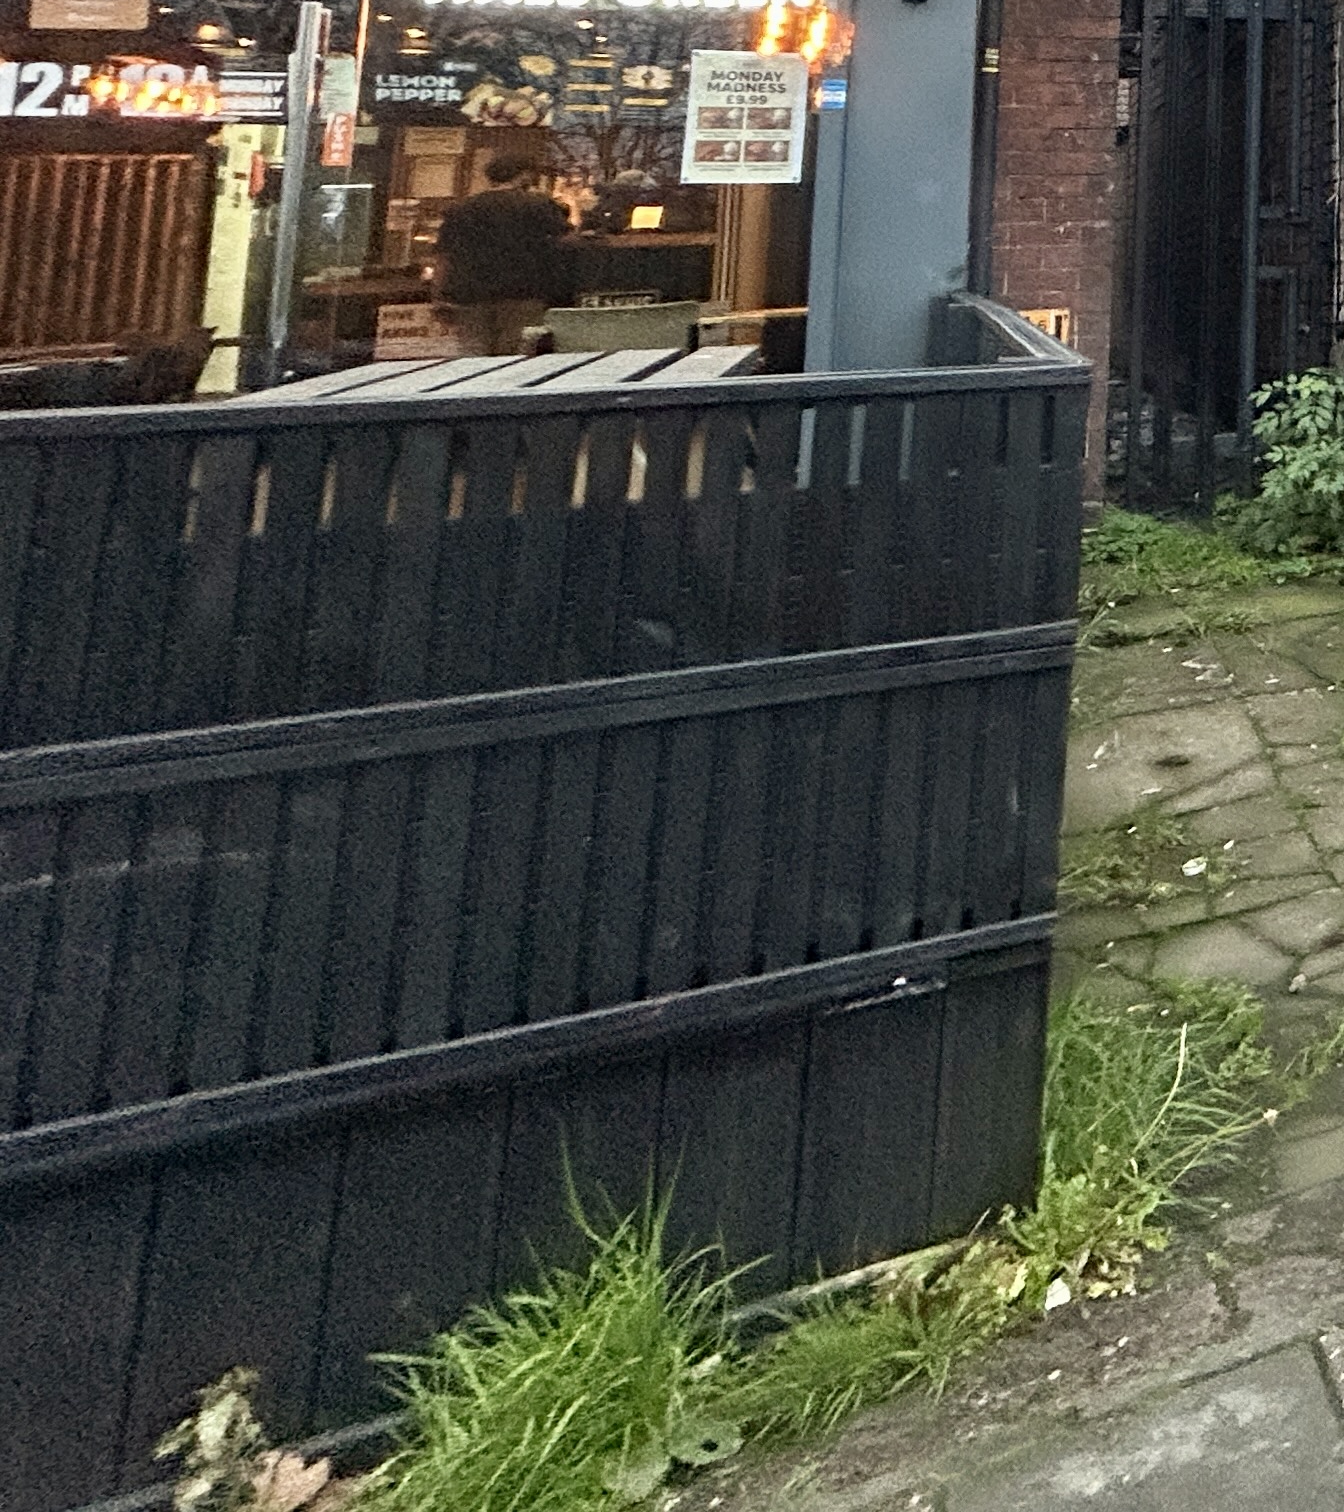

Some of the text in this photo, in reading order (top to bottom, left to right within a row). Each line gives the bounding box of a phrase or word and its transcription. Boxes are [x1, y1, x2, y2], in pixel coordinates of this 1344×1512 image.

[375, 74, 457, 89] LEMON
[710, 70, 785, 83] MONDAY
[706, 82, 787, 94] MADNESS
[374, 88, 463, 102] PEPPER
